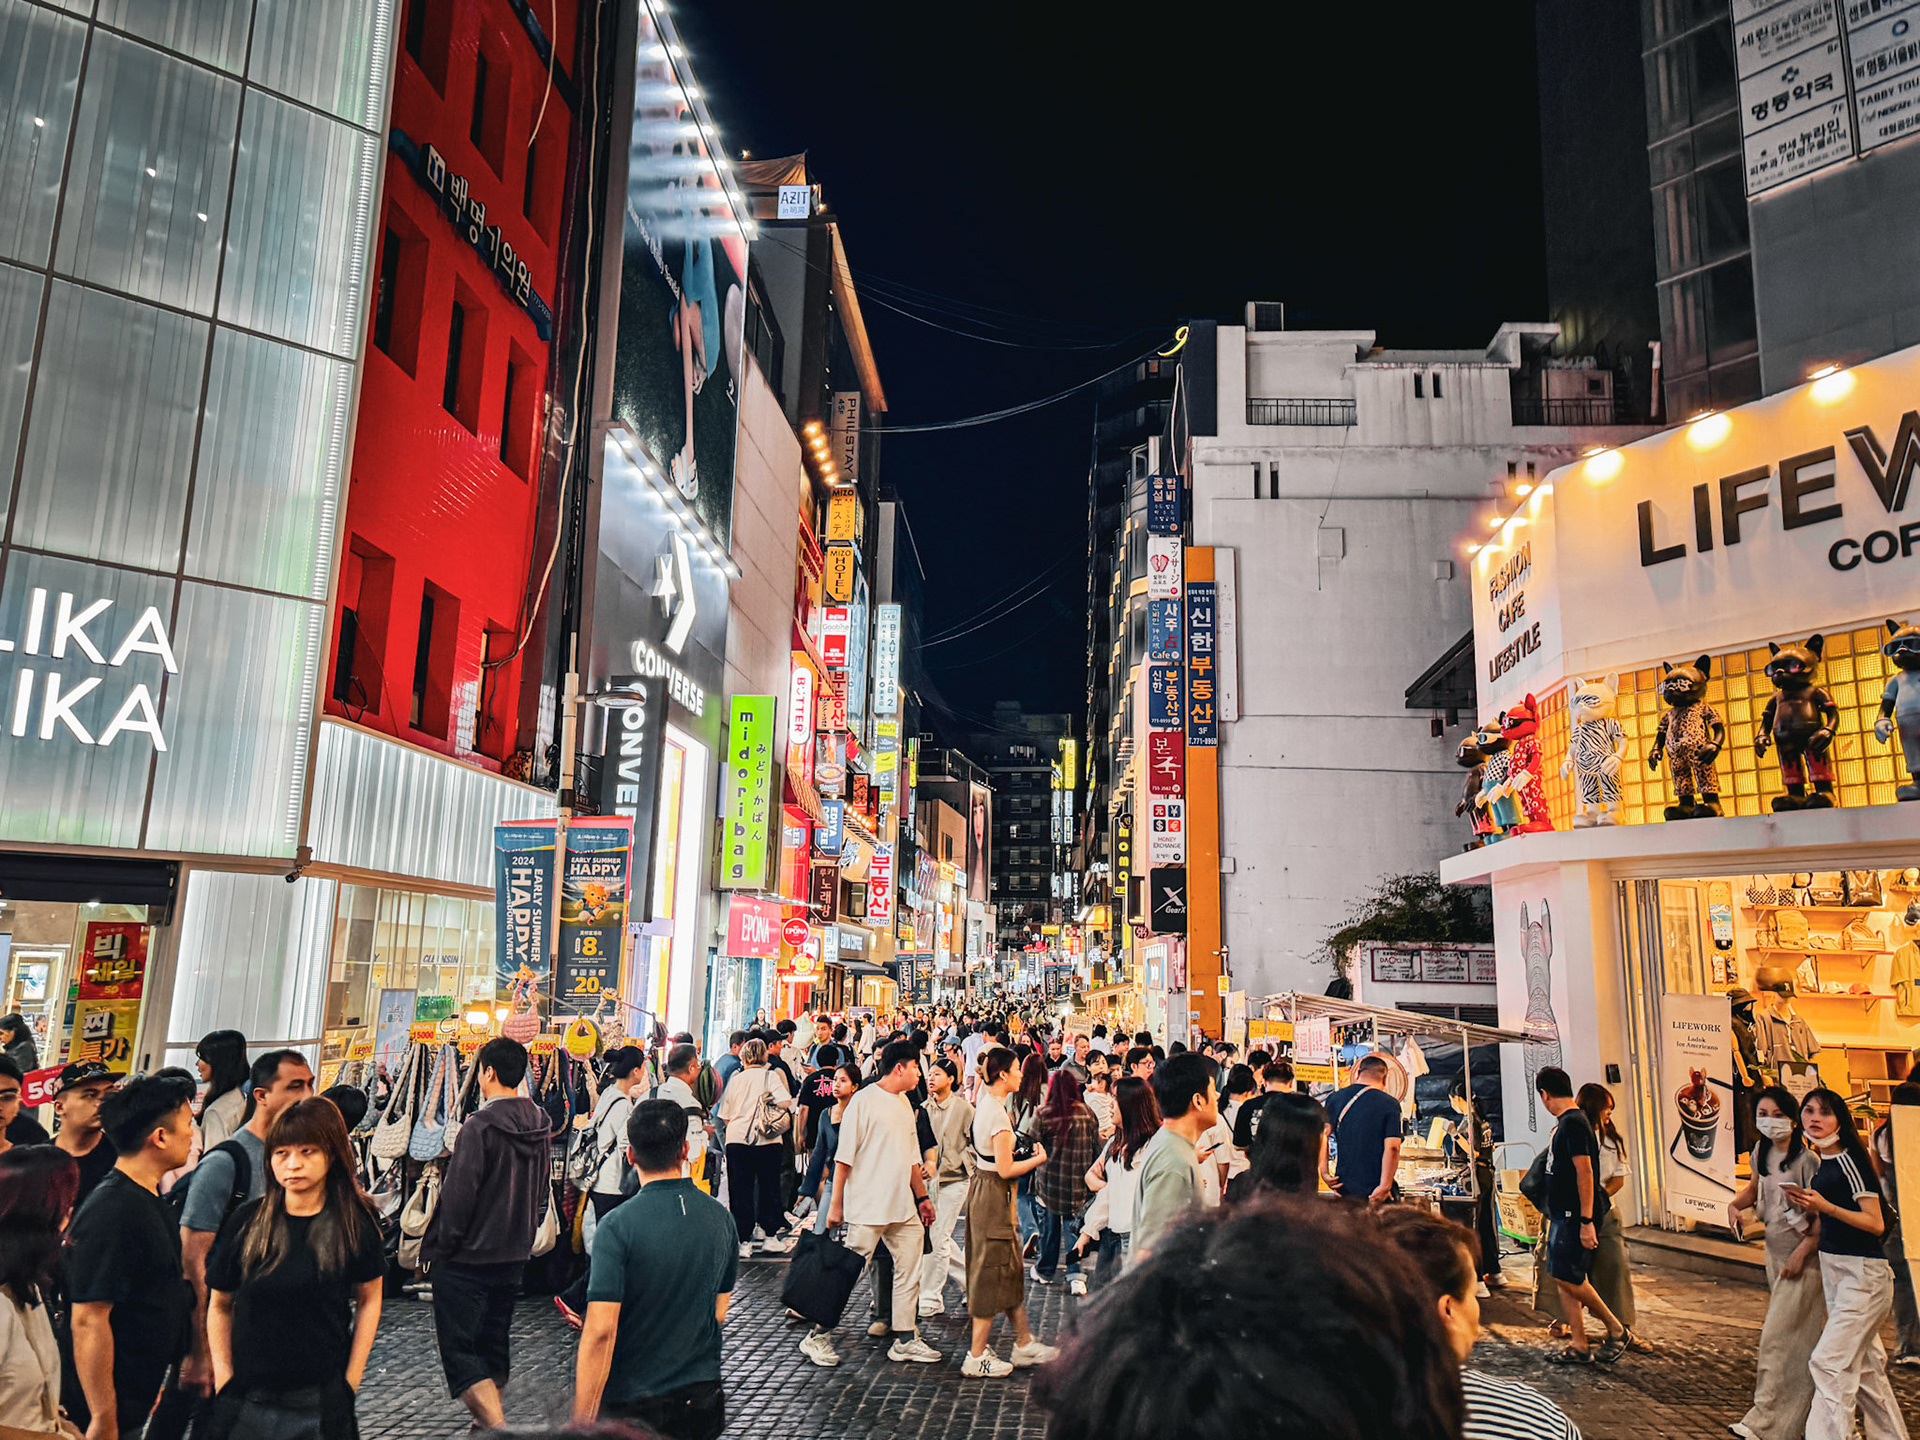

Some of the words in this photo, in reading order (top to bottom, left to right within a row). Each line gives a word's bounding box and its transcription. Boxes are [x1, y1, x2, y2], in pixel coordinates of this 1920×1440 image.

[780, 191, 809, 205] AZIT
[449, 172, 532, 307] 백명기의원
[832, 489, 854, 497] MIZO
[834, 557, 846, 595] HOTEL
[1489, 540, 1532, 602] FASHION
[1498, 590, 1526, 632] CAFE
[888, 623, 896, 668] BEAUTY
[1152, 651, 1171, 660] Cafe
[1489, 621, 1541, 683] LIFESTYLE
[630, 638, 705, 718] CONVERSE
[887, 671, 896, 694] LAB
[1151, 670, 1162, 694] 신한
[1164, 670, 1180, 717] 부동산
[750, 742, 767, 841] みどりかばん
[829, 806, 838, 838] EDIYA
[512, 856, 535, 866] 2024
[570, 864, 621, 877] HAPPY
[532, 868, 544, 906] EARLY
[869, 855, 891, 918] 부동산
[511, 868, 533, 962] HAPPY
[1165, 905, 1186, 914] GearX
[94, 933, 123, 960] 빅
[506, 932, 514, 961] EVENT
[531, 908, 543, 963] SUMMER
[582, 936, 598, 956] 8
[90, 958, 136, 982] 세일
[574, 976, 600, 993] 20
[82, 1011, 111, 1040] 찐
[413, 1031, 435, 1039] 15000
[1672, 1021, 1721, 1033] LIFEWORK
[1686, 1042, 1719, 1051] Americano
[1684, 1198, 1717, 1210] LIFEWORK
